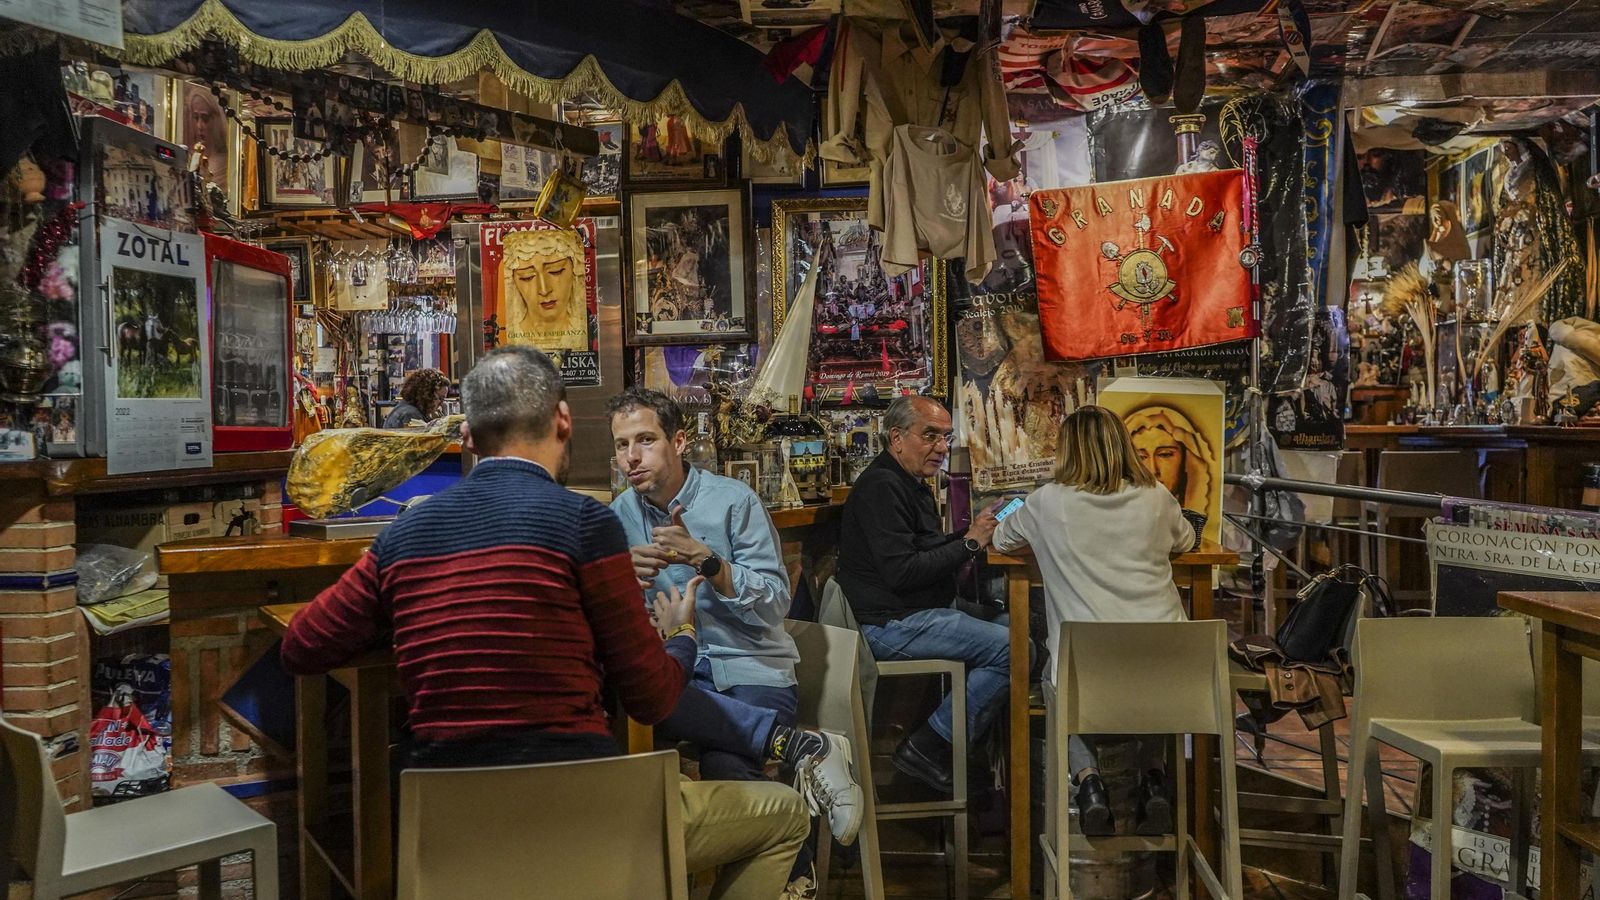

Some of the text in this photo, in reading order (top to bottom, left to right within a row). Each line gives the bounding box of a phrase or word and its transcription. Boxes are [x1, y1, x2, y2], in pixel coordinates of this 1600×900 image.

[1047, 187, 1226, 246] GRANADA
[117, 231, 190, 267] ZOTAL
[543, 329, 587, 338] ESPERANZA
[1436, 529, 1557, 554] CORONACIÓN
[1435, 545, 1478, 561] NTRA.
[1484, 550, 1514, 566] SRA.
[1521, 555, 1541, 569] DE
[1547, 557, 1567, 572] LA
